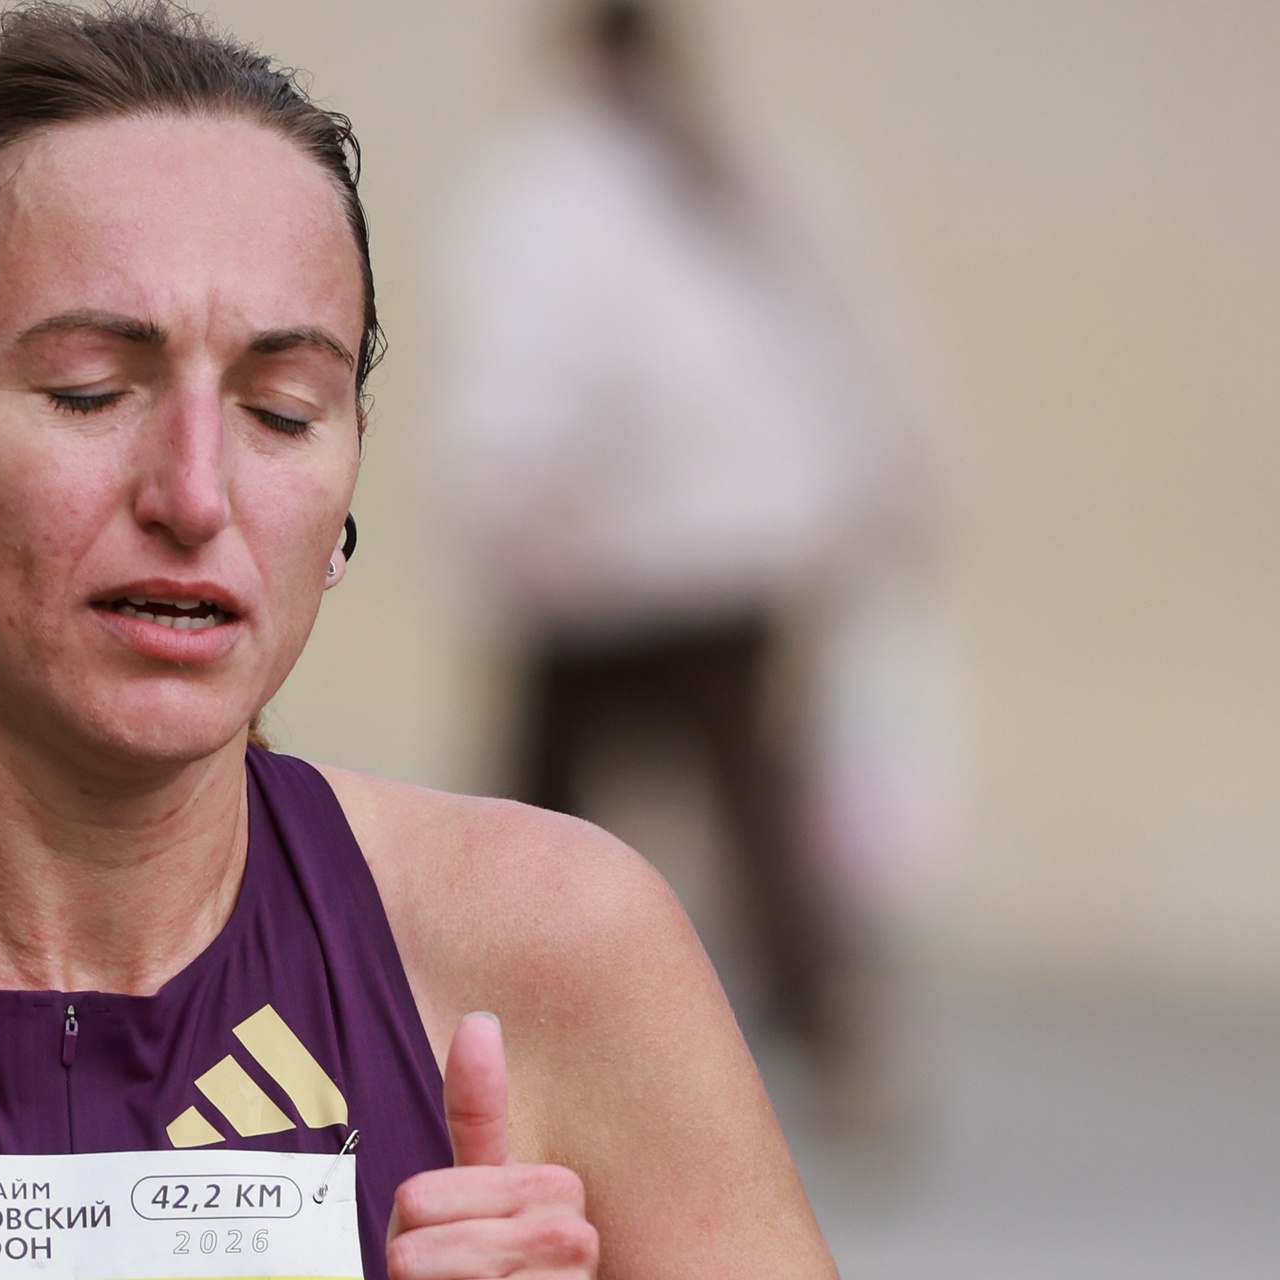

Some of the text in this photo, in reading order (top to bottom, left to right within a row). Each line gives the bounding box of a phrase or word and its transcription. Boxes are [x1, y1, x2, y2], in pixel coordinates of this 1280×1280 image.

[151, 1183, 281, 1213] 42,2 КМ
[173, 1229, 269, 1255] 2026
